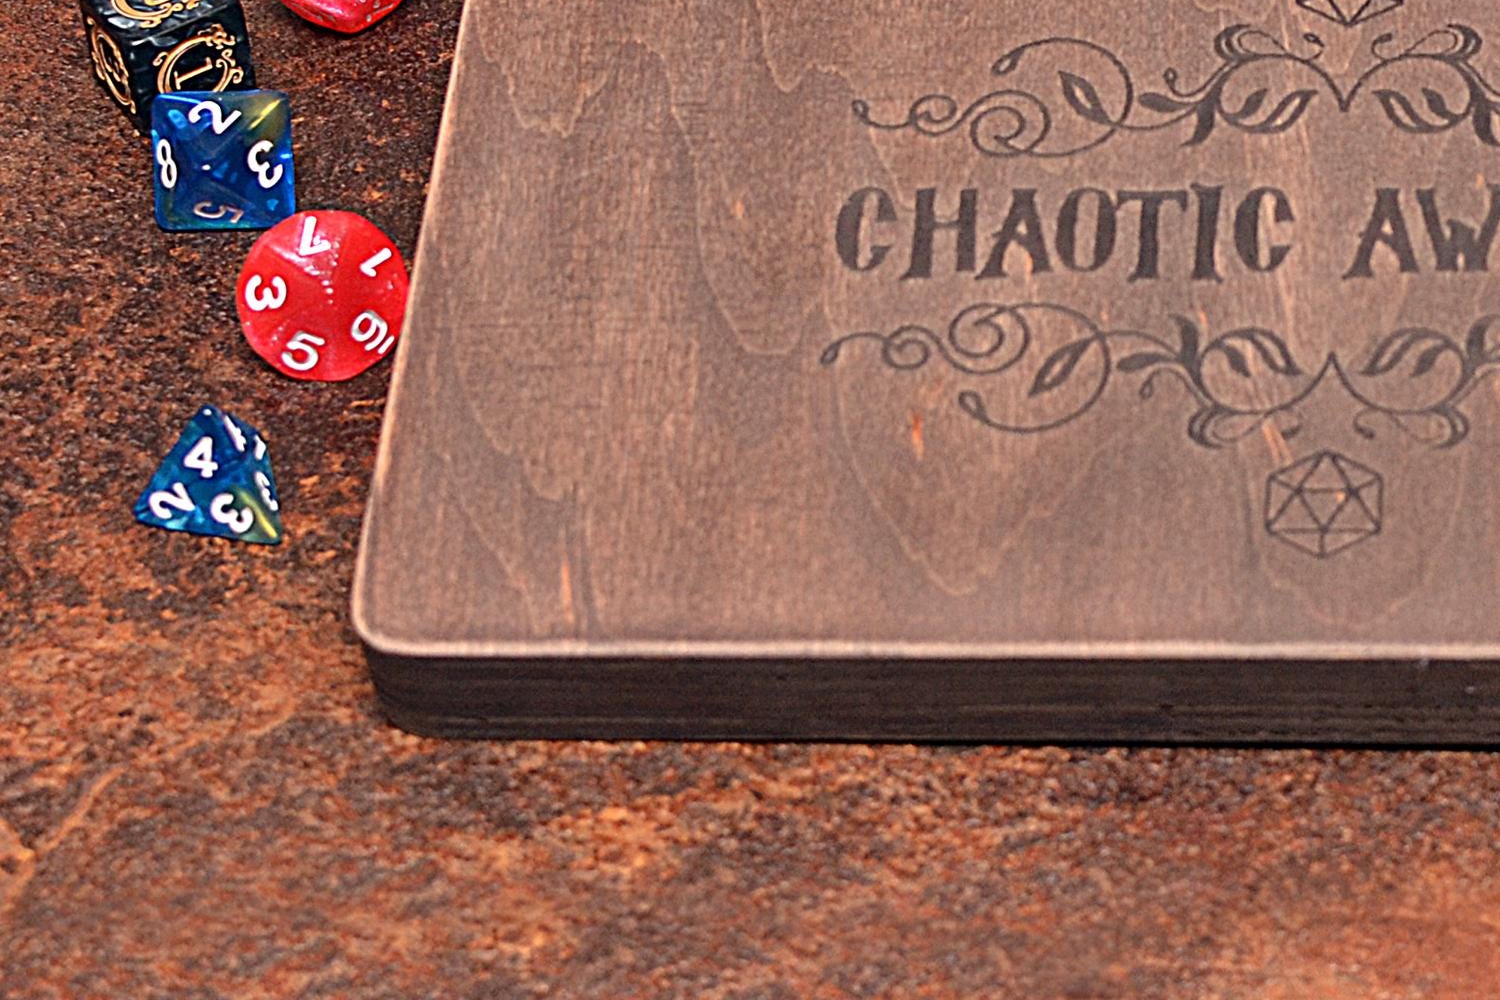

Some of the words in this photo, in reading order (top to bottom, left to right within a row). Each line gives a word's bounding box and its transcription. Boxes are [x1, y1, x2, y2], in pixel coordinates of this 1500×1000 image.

[188, 101, 242, 134] 2
[156, 139, 178, 189] 8
[247, 139, 284, 189] 3
[299, 216, 332, 256] 7
[834, 183, 1294, 282] CHAOTIC
[360, 247, 392, 278] 1
[245, 274, 287, 312] 3
[281, 331, 325, 372] 5
[184, 436, 219, 478] 4
[149, 482, 196, 519] 2
[210, 492, 254, 533] 3
